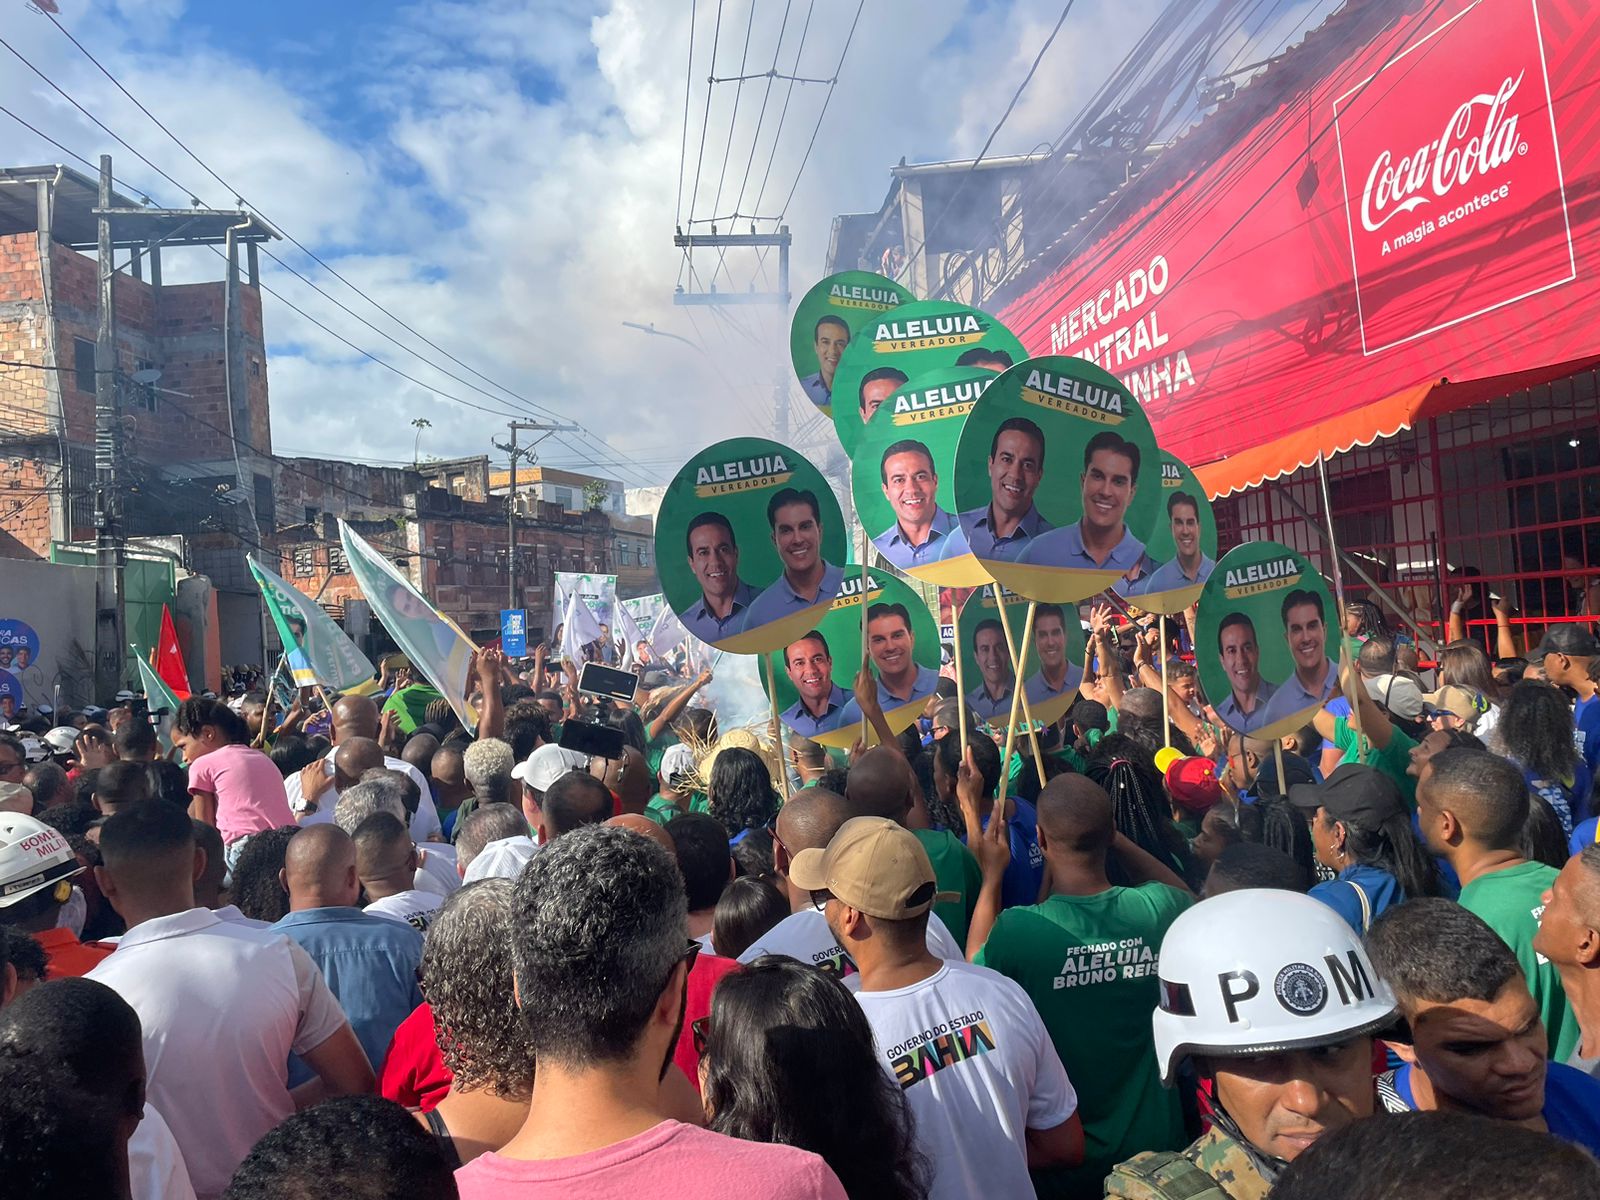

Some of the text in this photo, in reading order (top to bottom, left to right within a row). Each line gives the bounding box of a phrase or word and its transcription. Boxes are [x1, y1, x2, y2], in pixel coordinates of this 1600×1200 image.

[1361, 67, 1525, 231] Coca-Cola
[1381, 187, 1509, 256] A magia acontece
[830, 284, 900, 305] ALELUIA
[839, 299, 890, 311] VEREADOR
[1050, 255, 1169, 355] MERCADO
[875, 315, 980, 341] ALELUIA
[891, 335, 966, 350] VEREADOR
[1072, 311, 1169, 371] NTRAL
[1025, 369, 1123, 414] ALELUIA
[910, 403, 974, 421] VEREADO
[1038, 394, 1107, 422] VEREADOR
[696, 455, 788, 485] ALELUIA
[711, 477, 777, 494] VEREADOR
[1225, 558, 1298, 587] ALELUIA
[1237, 578, 1289, 595] VEREADOR
[1060, 945, 1154, 976] ALELUIA
[1067, 936, 1143, 957] FECHADO COM
[1053, 967, 1117, 990] BRUNO
[1218, 950, 1375, 1023] P M
[886, 1010, 985, 1060] GOVERNO DO ESTADO
[890, 1021, 996, 1091] BAHIA
